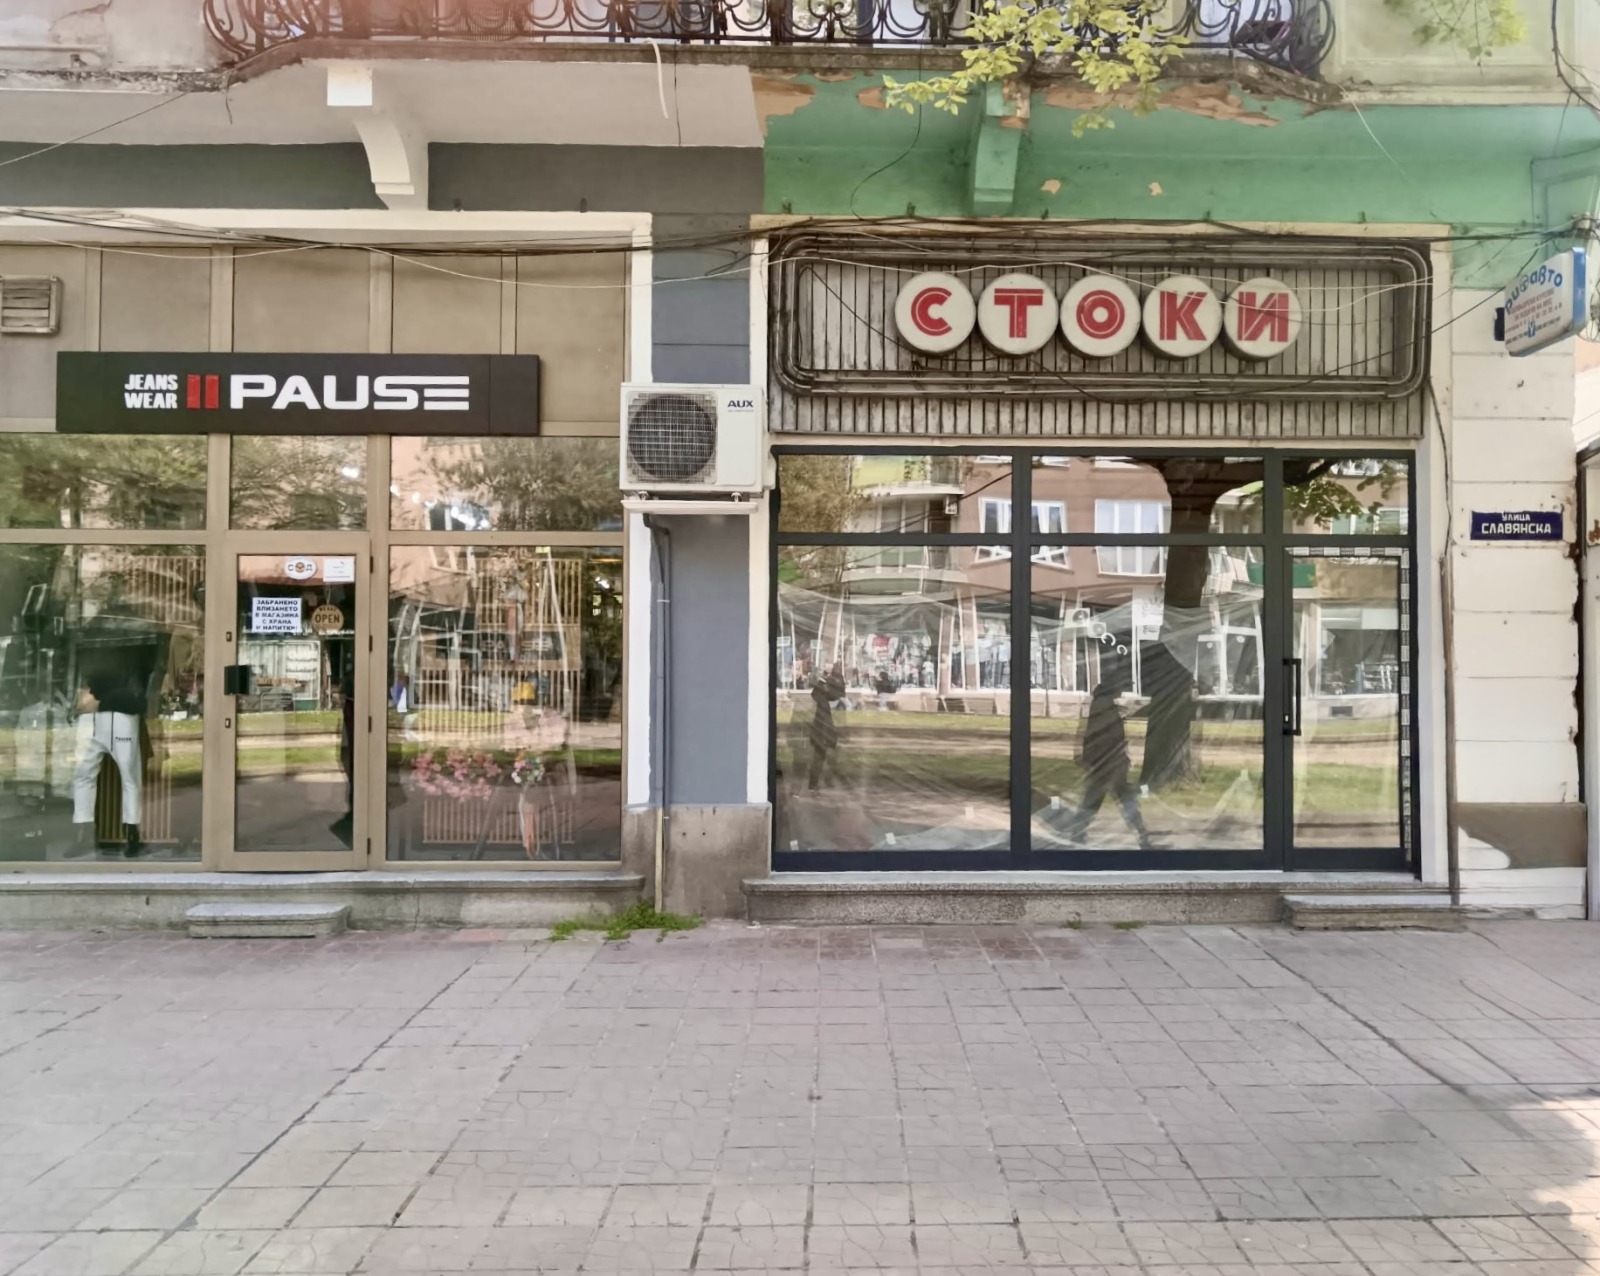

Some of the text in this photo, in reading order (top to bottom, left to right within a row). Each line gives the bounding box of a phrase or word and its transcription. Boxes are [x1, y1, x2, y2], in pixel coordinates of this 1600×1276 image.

[911, 287, 1289, 342] СТОКИ
[124, 374, 178, 391] JEANS
[230, 374, 470, 411] PAUSE
[124, 391, 178, 409] WEAR
[727, 399, 754, 408] AUX
[1502, 513, 1531, 521] УЛИЦА
[1481, 523, 1552, 534] СЛАВЯНСКА
[314, 614, 340, 624] OPEN
